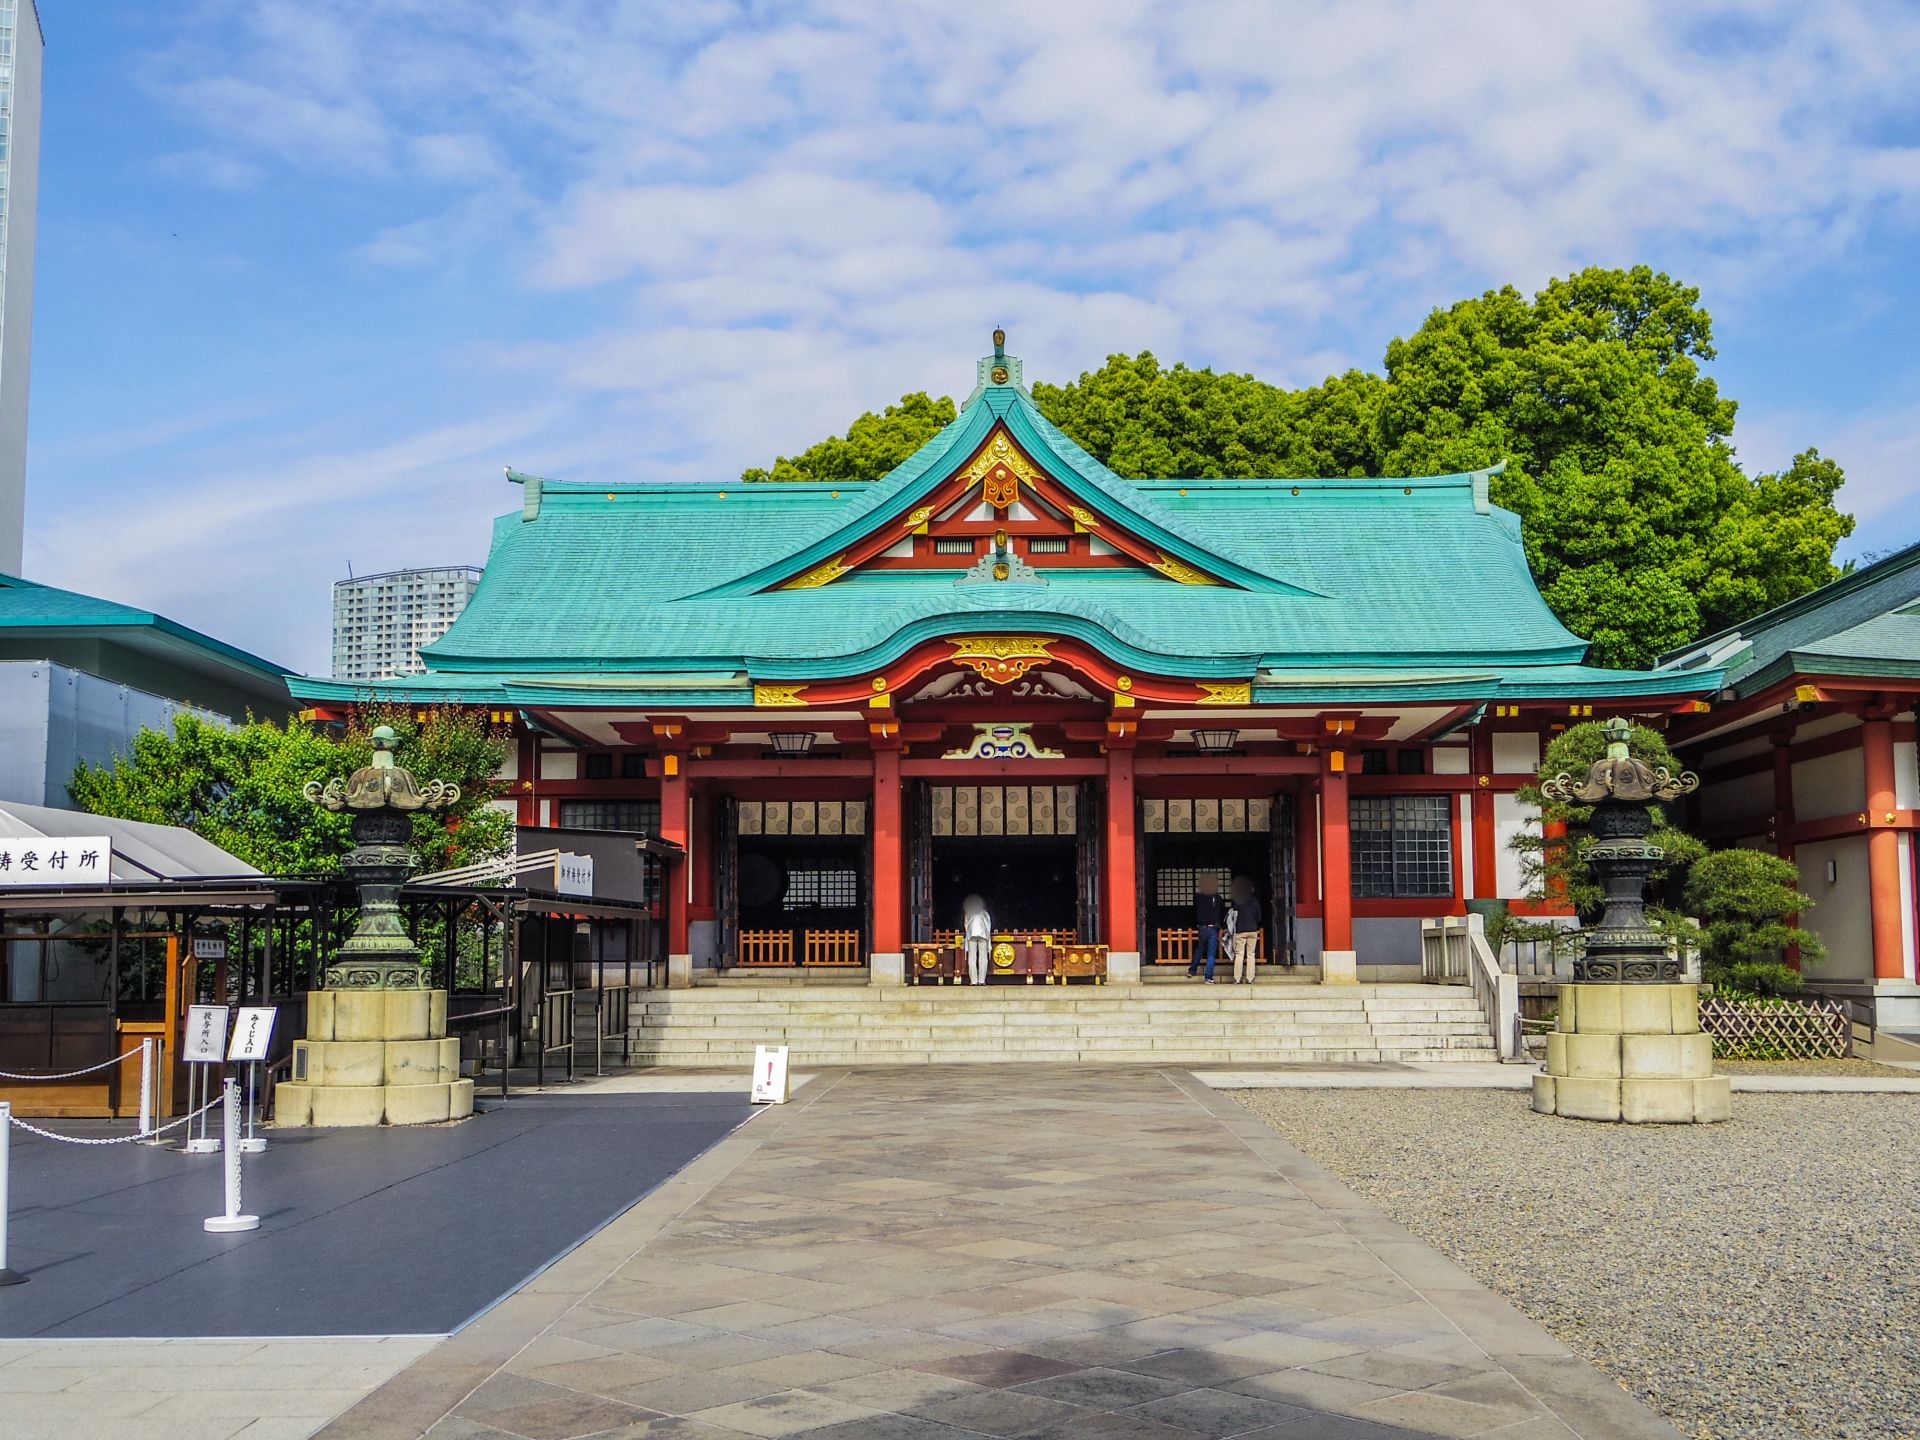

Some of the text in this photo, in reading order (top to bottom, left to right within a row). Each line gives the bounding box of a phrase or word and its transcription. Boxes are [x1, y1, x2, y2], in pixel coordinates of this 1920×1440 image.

[200, 1011, 213, 1054] 授与所入口
[244, 1013, 260, 1054] みくじ入口
